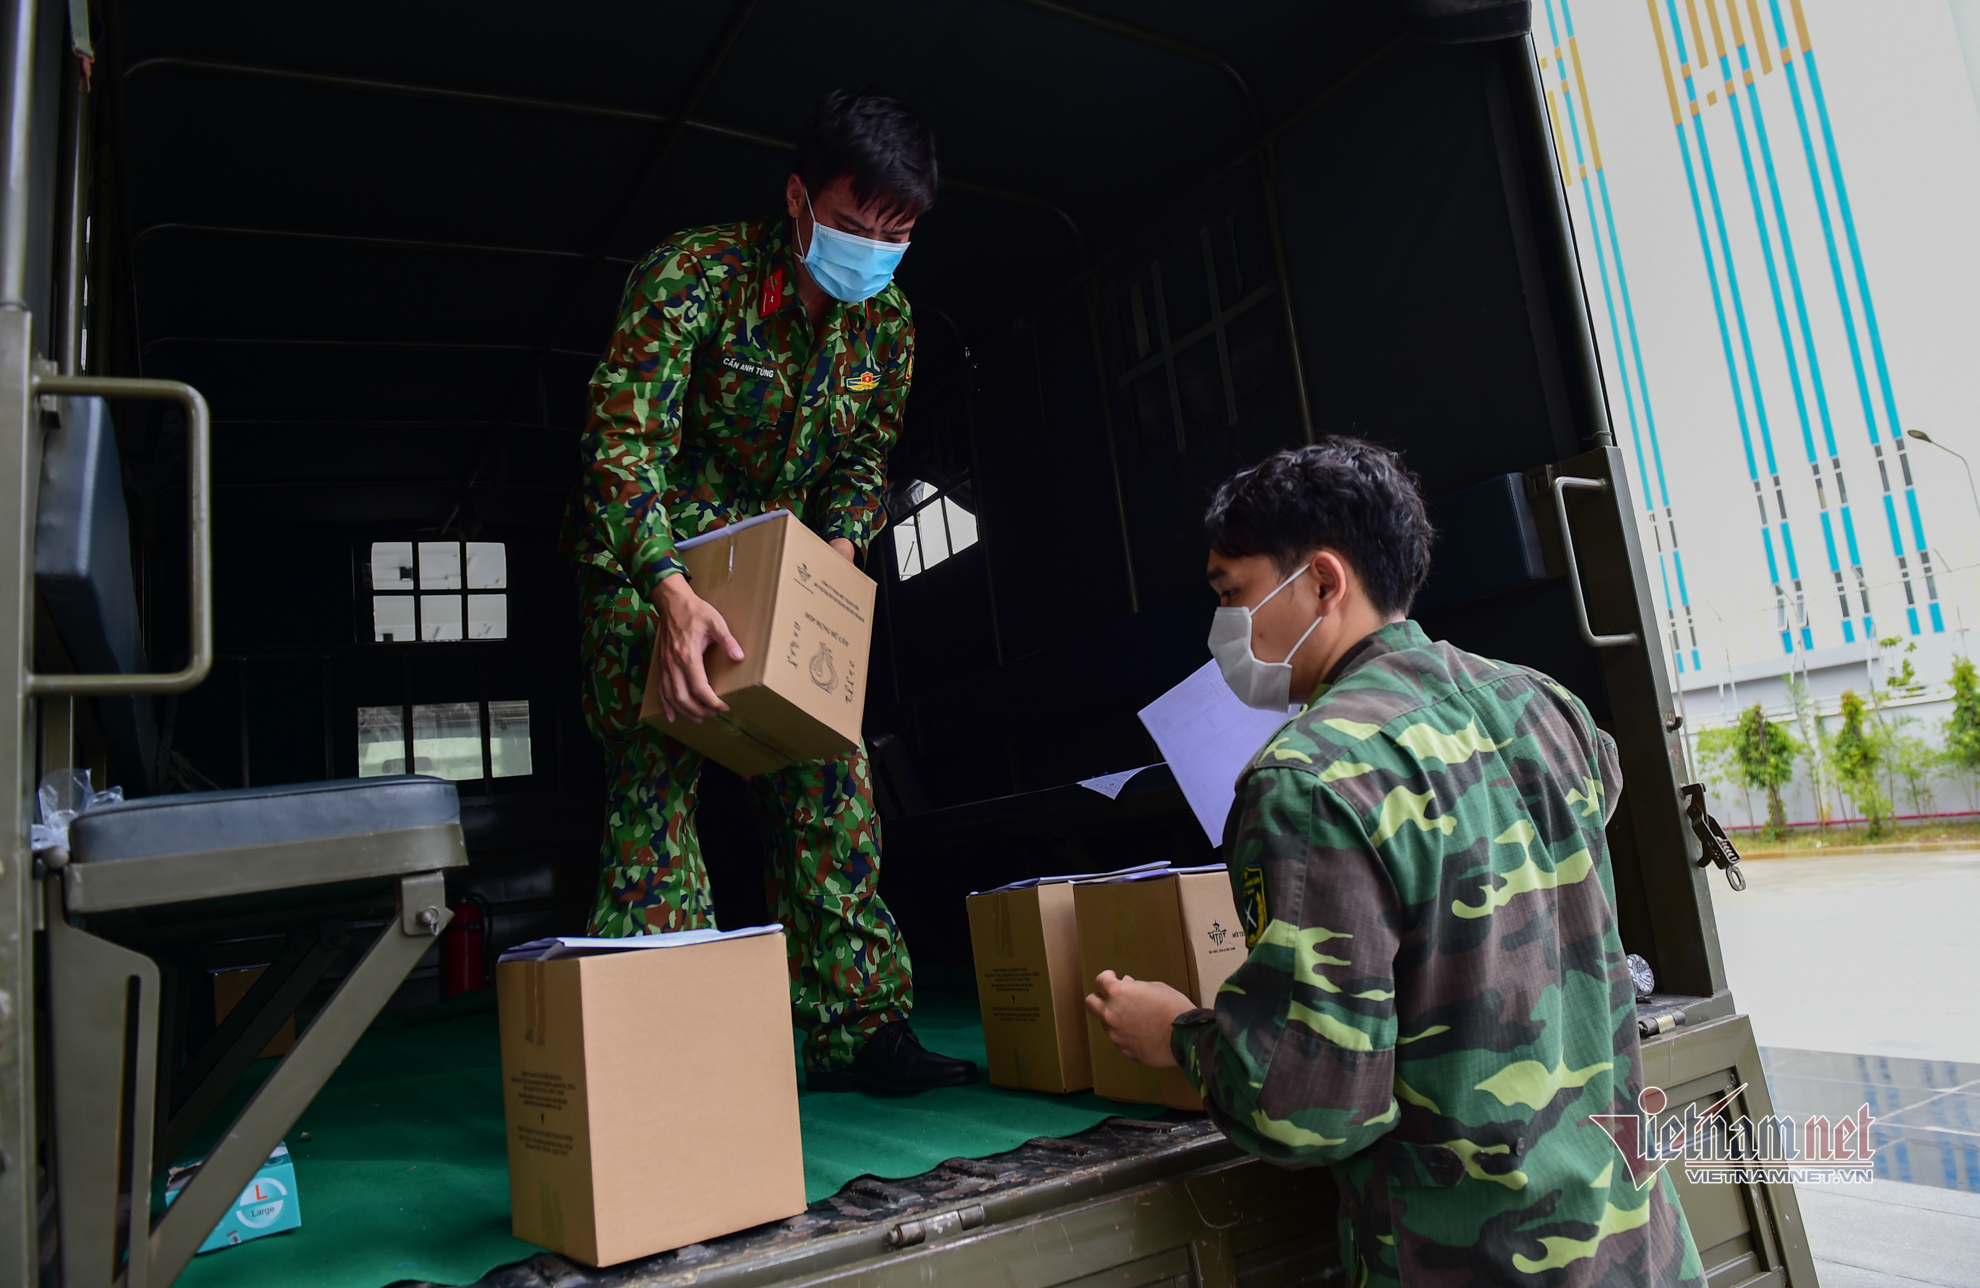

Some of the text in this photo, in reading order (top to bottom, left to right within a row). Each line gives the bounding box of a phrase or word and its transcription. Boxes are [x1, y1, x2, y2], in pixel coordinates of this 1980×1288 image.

[739, 363, 755, 373] ANH
[755, 366, 774, 378] TÙNG
[255, 1184, 268, 1201] L
[251, 1206, 275, 1218] Large
